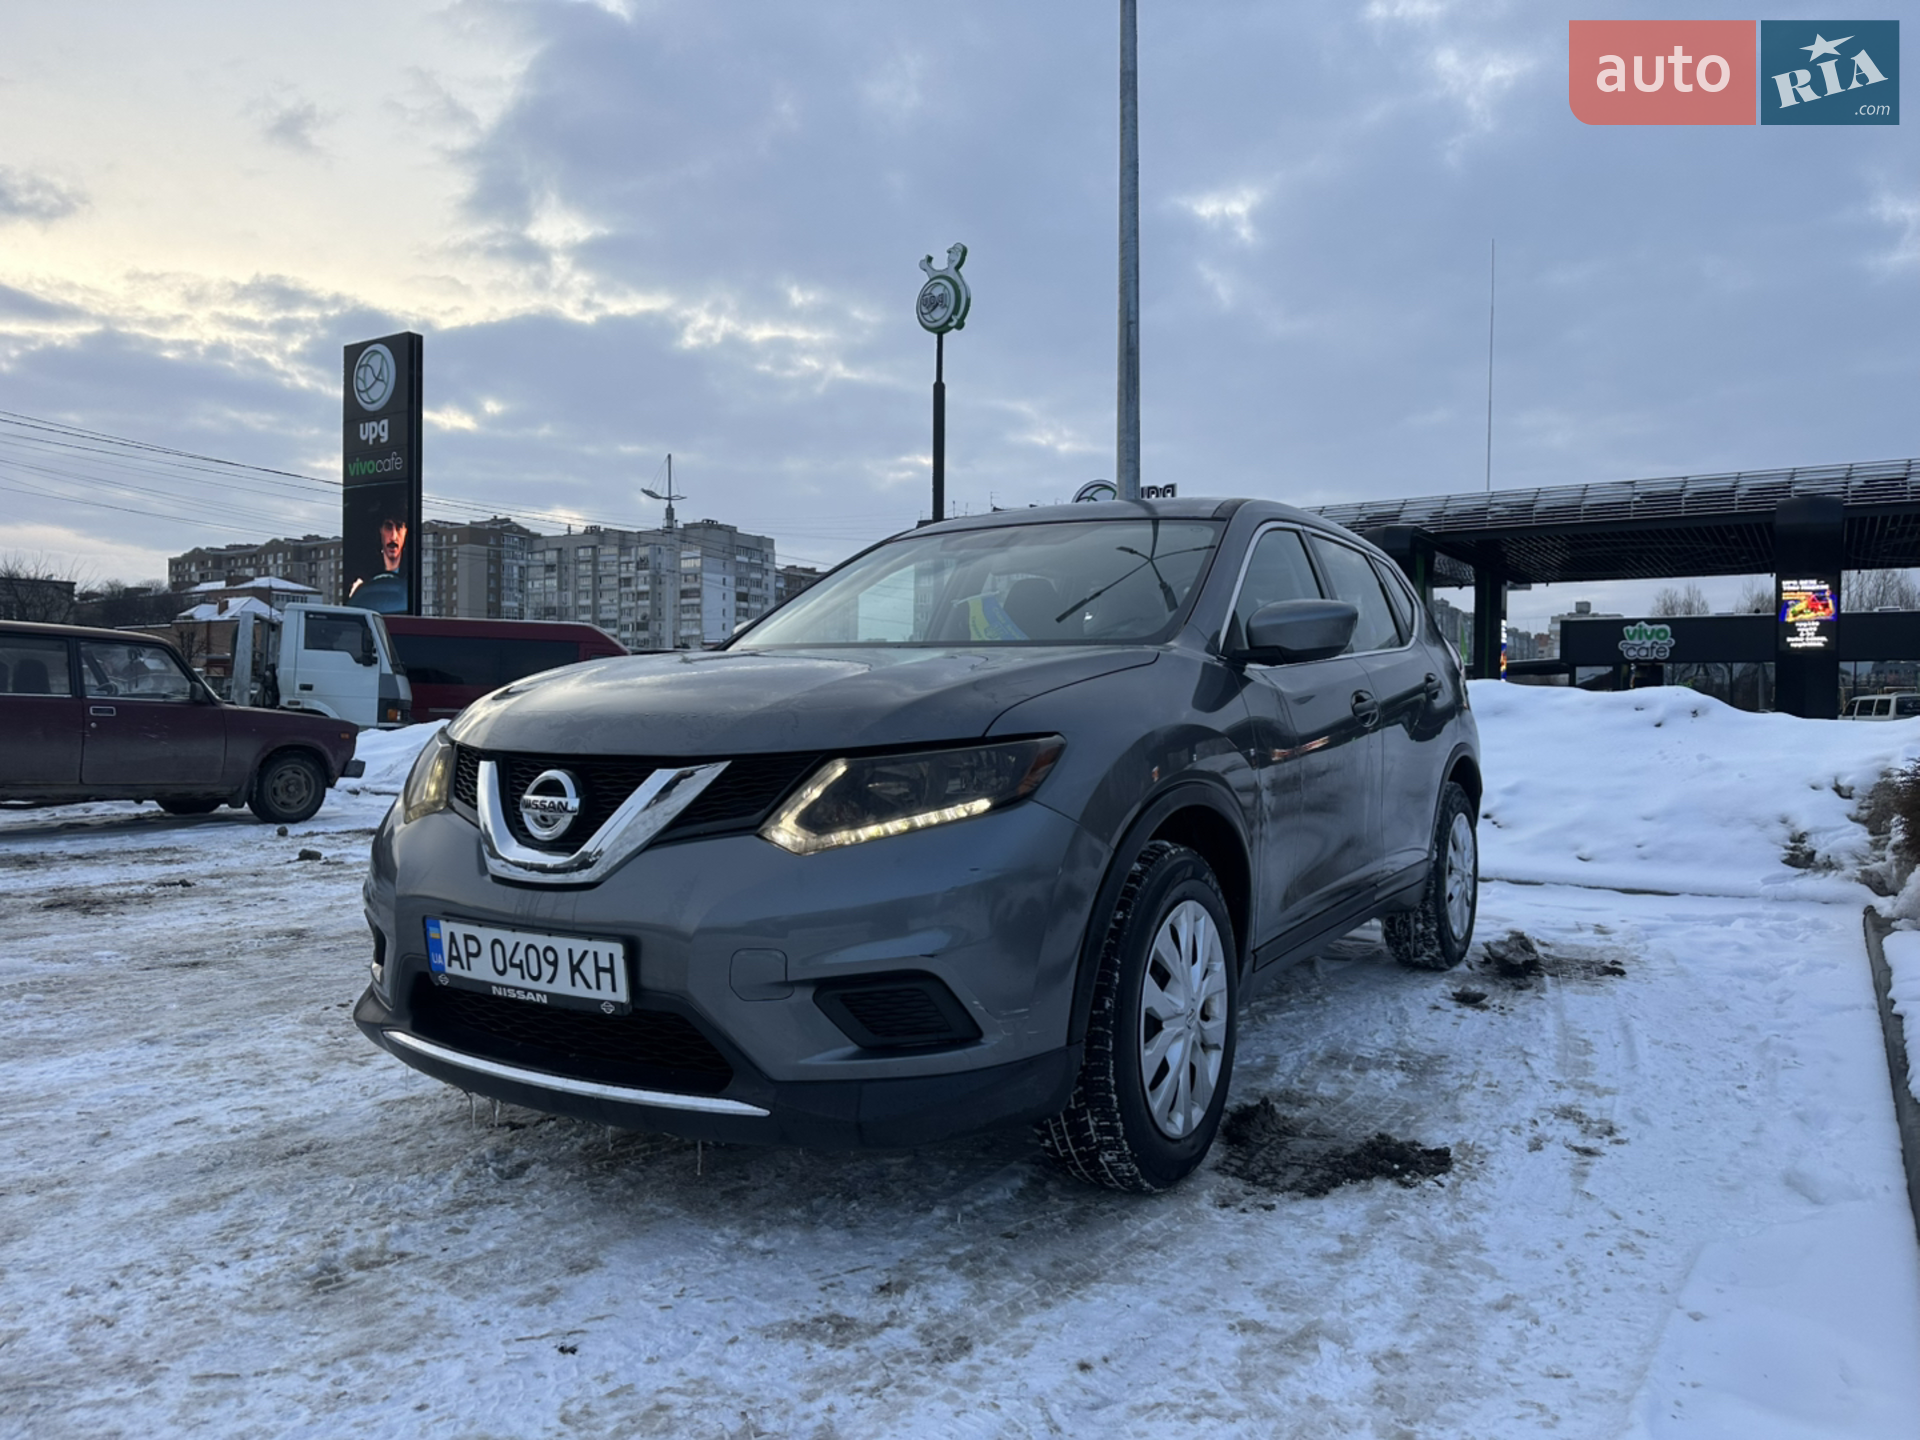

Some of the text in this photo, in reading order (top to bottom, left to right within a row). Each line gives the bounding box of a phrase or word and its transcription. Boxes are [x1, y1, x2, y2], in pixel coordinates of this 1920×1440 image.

[359, 419, 389, 445] upg
[1625, 624, 1670, 641] vivo
[522, 797, 569, 813] NISSAN
[431, 952, 444, 965] UA
[447, 931, 617, 993] AP 0409 KH
[491, 985, 548, 1004] NISSAN
